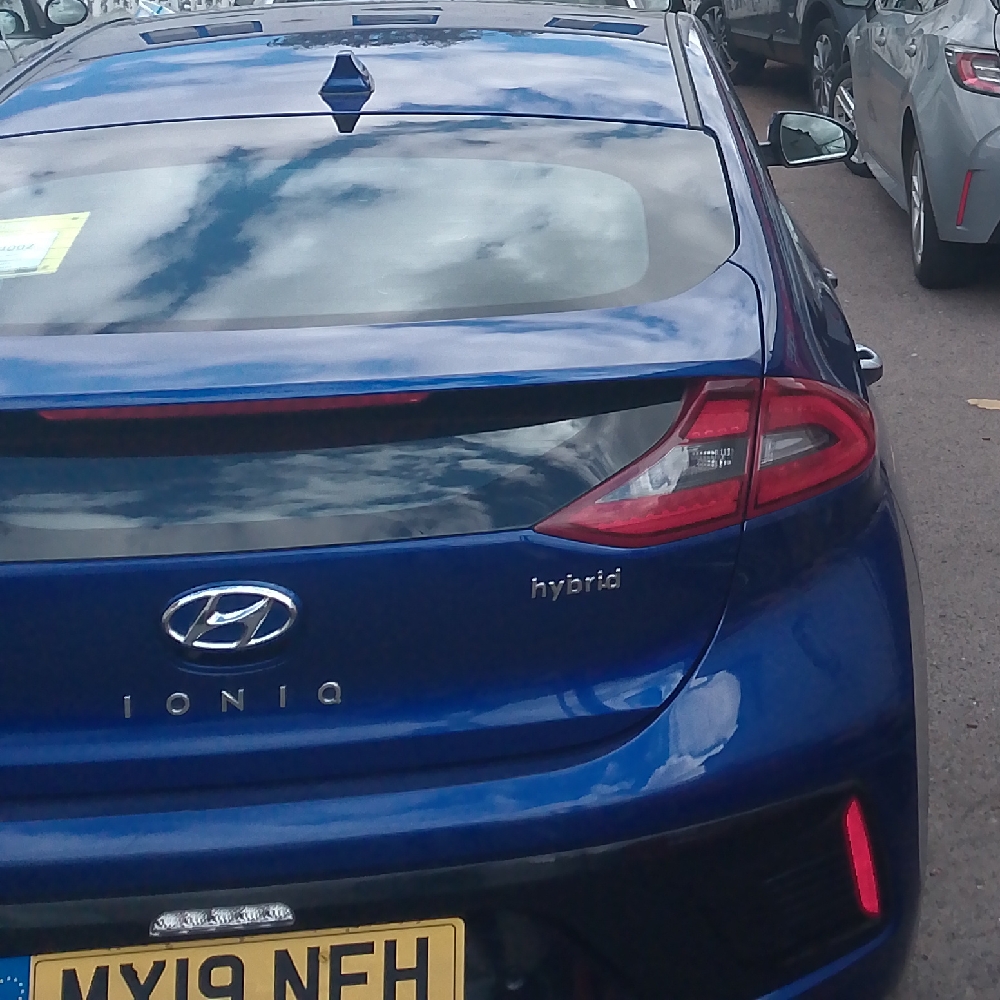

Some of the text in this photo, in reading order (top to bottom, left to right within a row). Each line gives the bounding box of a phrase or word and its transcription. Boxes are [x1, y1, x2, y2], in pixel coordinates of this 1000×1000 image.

[530, 567, 622, 602] hybrid
[122, 681, 343, 719] IONIQ
[273, 936, 430, 1000] NFH
